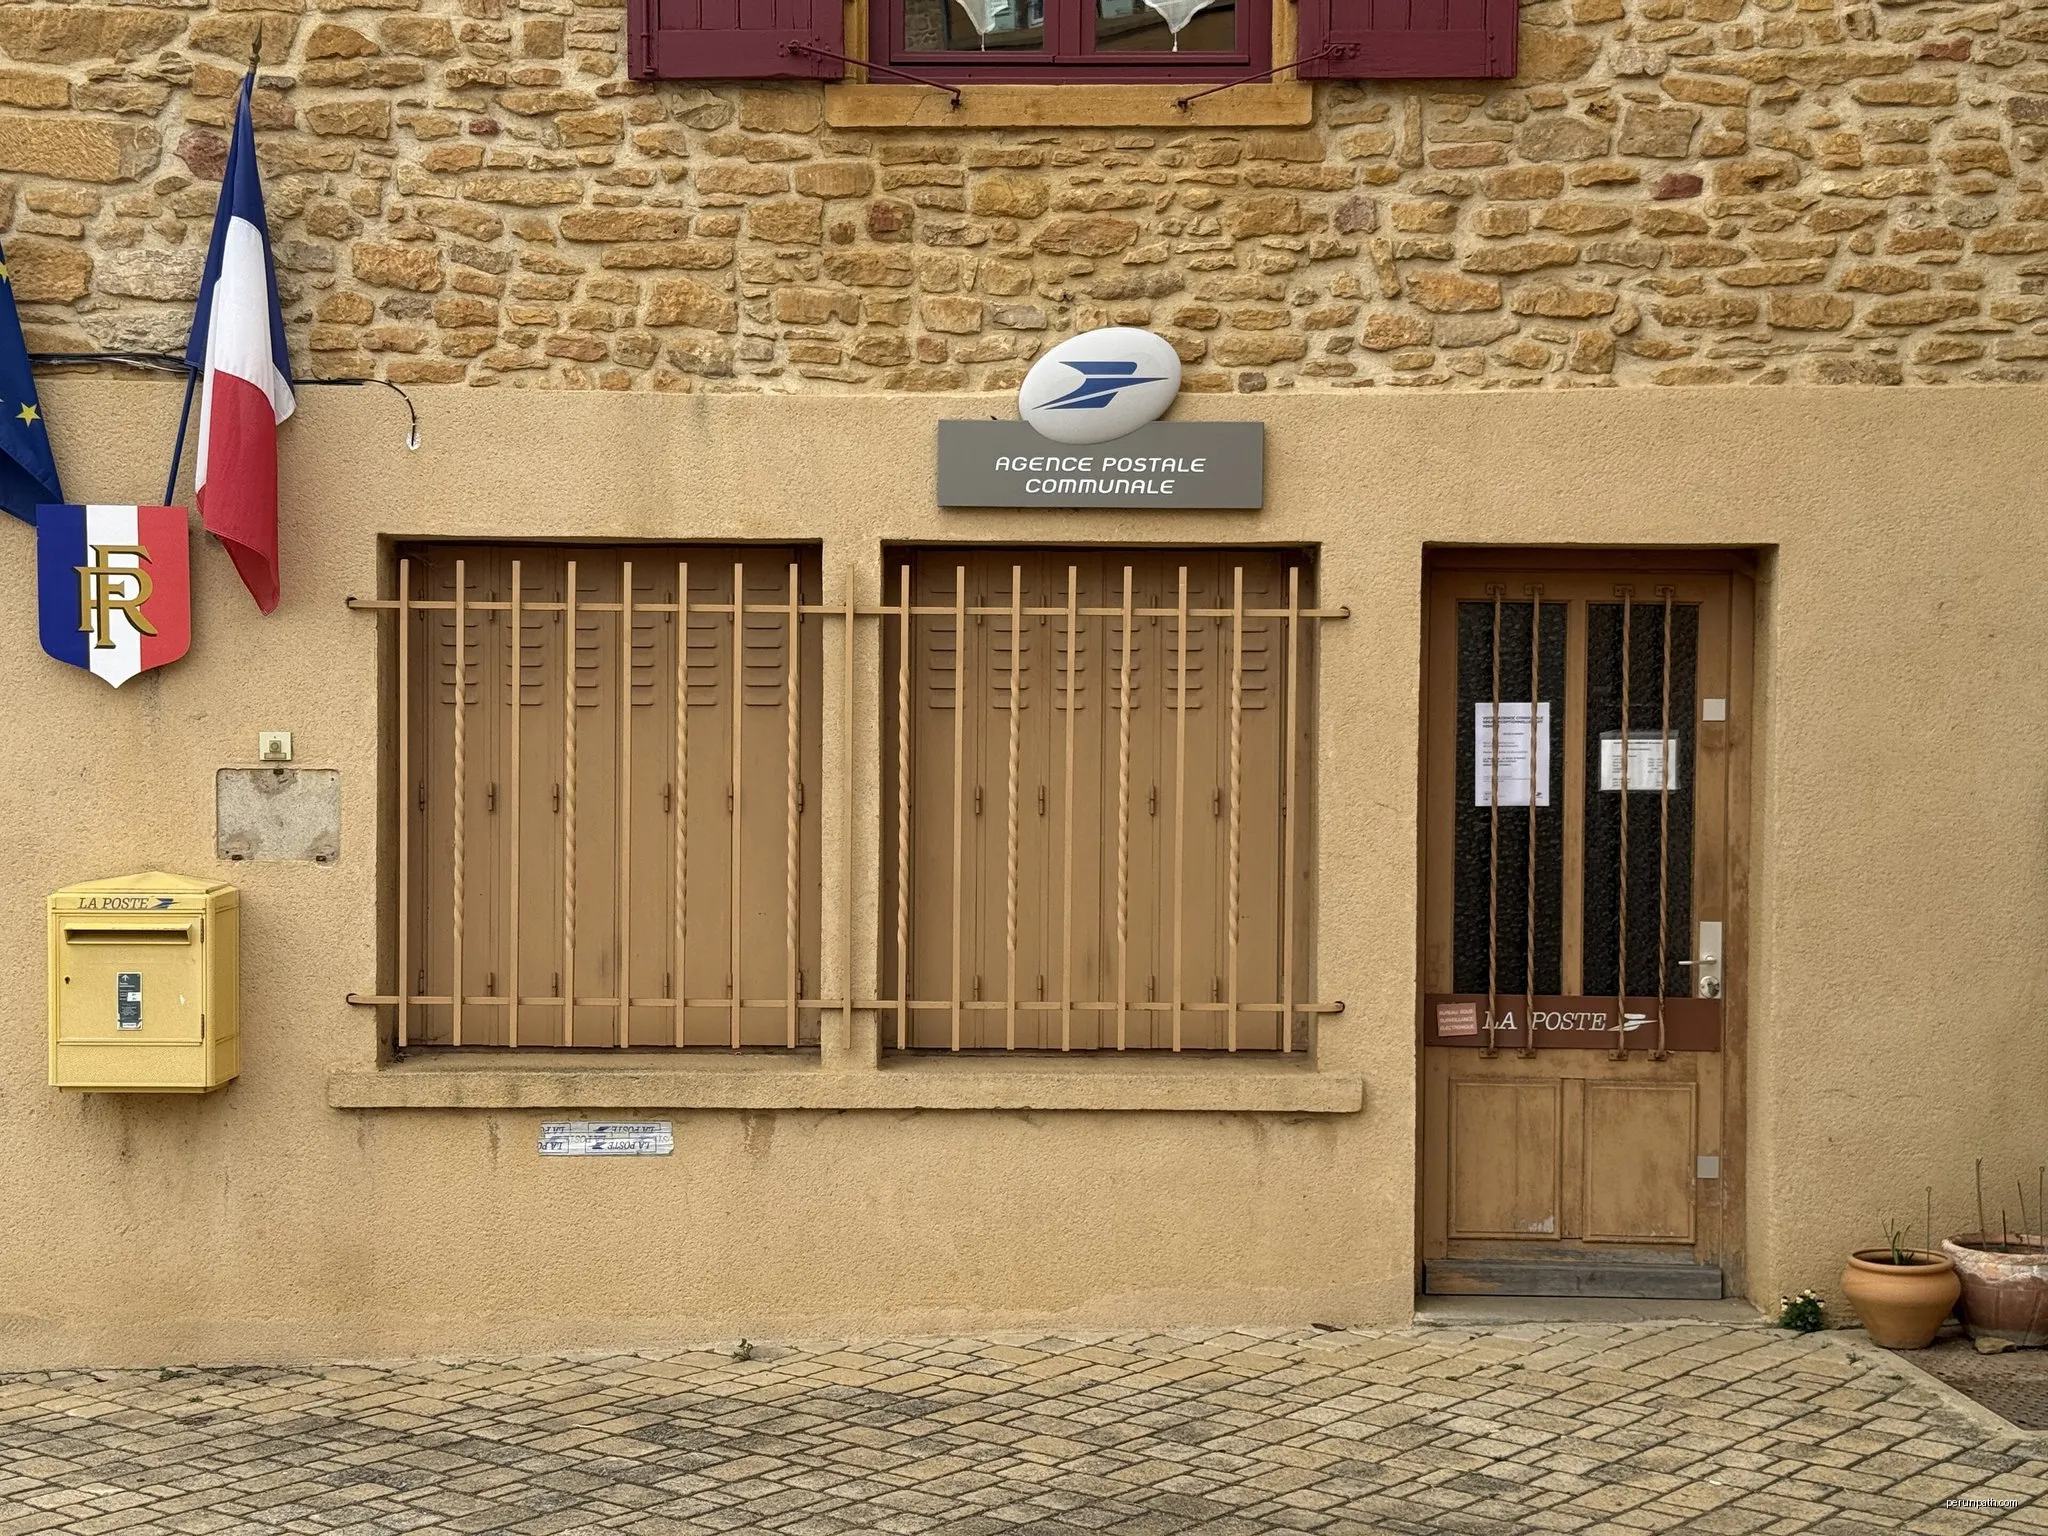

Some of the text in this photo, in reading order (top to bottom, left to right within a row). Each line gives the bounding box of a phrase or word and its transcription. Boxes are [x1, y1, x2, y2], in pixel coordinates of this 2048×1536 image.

[995, 456, 1207, 473] AGENCE POSTALE
[1025, 478, 1176, 495] COMMUNALE
[77, 897, 149, 910] LA POSTE
[1481, 1011, 1607, 1032] LA POSTE
[607, 1141, 650, 1150] LA POSTE
